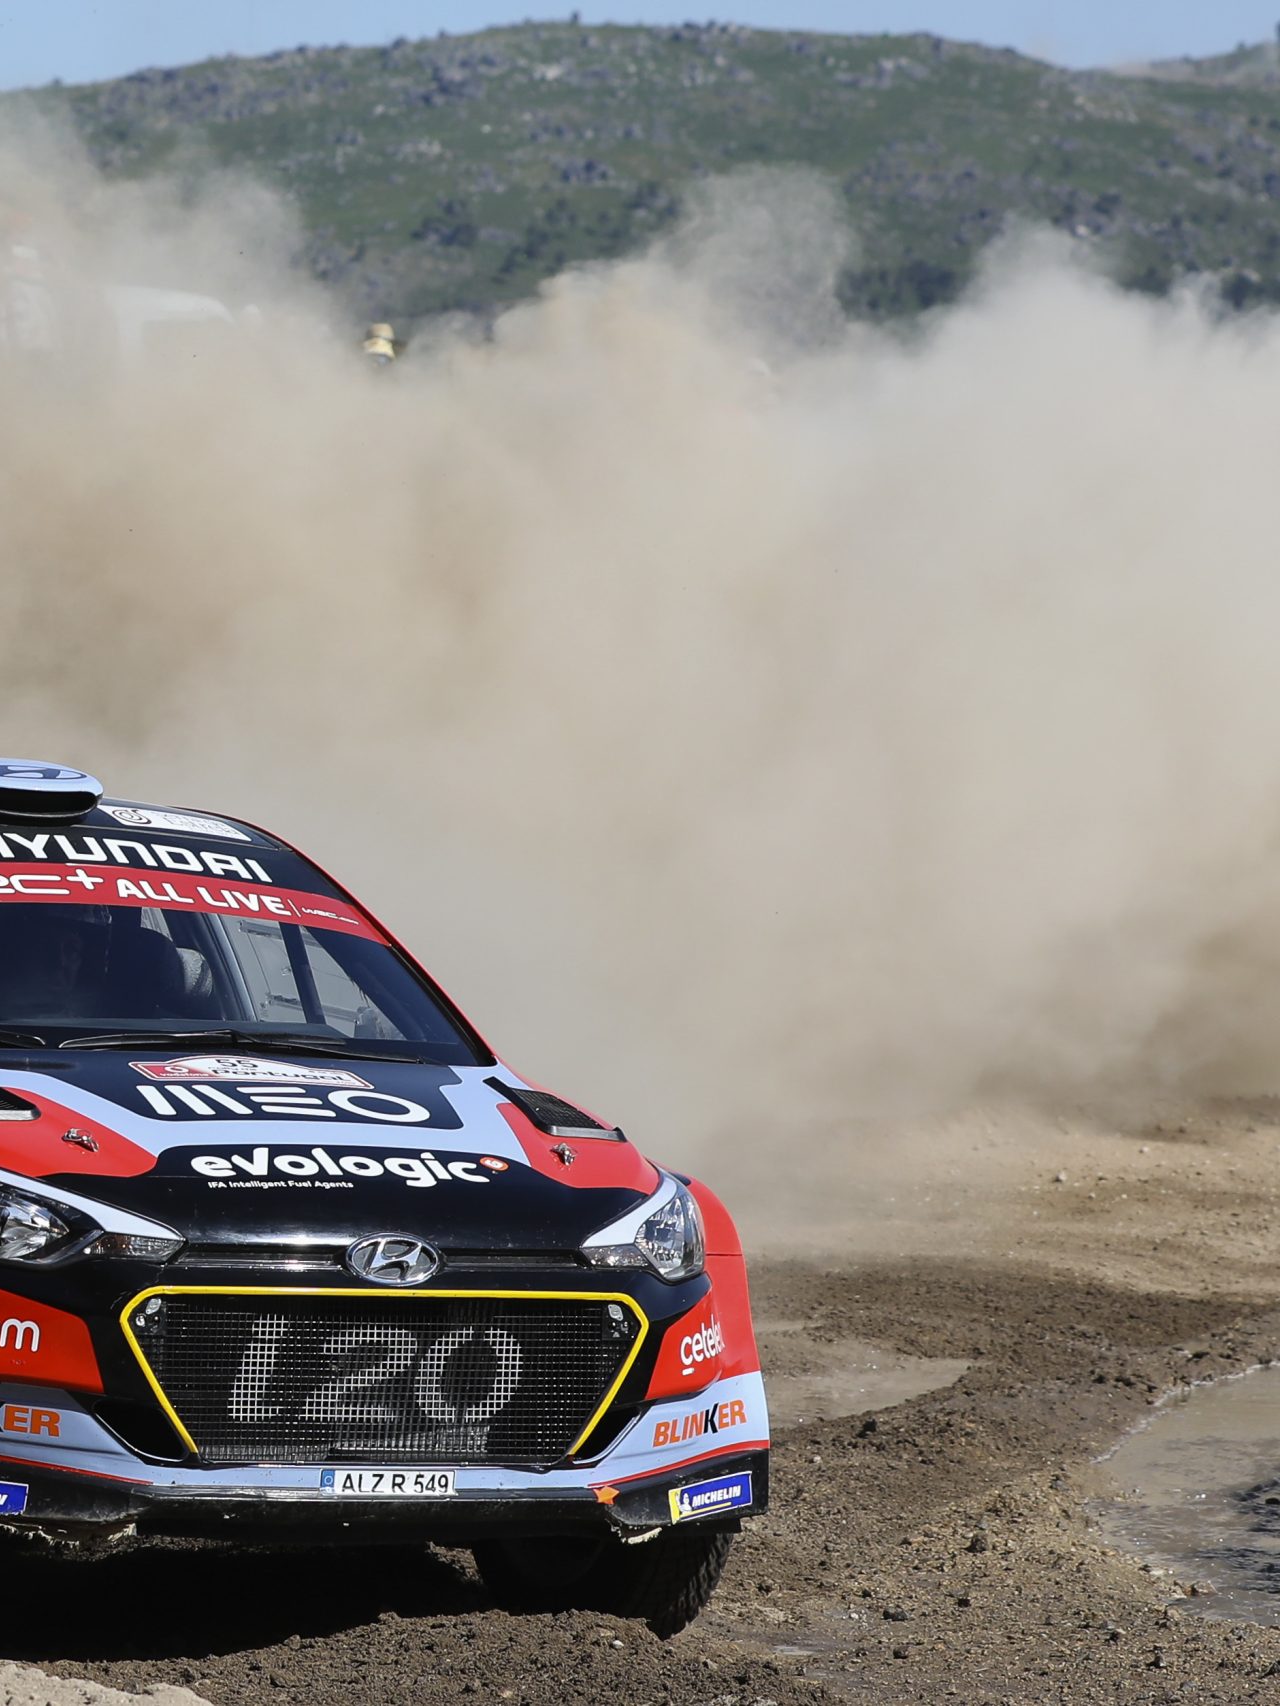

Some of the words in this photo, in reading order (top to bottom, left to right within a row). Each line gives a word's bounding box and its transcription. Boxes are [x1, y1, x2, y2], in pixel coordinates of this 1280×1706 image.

[116, 878, 194, 904] ALL
[196, 886, 291, 916] LIVE
[215, 1059, 259, 1068] 55
[135, 1085, 431, 1123] MEO
[190, 1147, 491, 1188] evologic
[228, 1181, 287, 1189] Intelligent
[314, 1181, 354, 1189] Agents
[652, 1399, 747, 1448] BLINKER
[342, 1473, 384, 1493] ALZ
[391, 1474, 406, 1493] R
[414, 1474, 449, 1493] 549
[692, 1485, 741, 1507] MICHELIN
